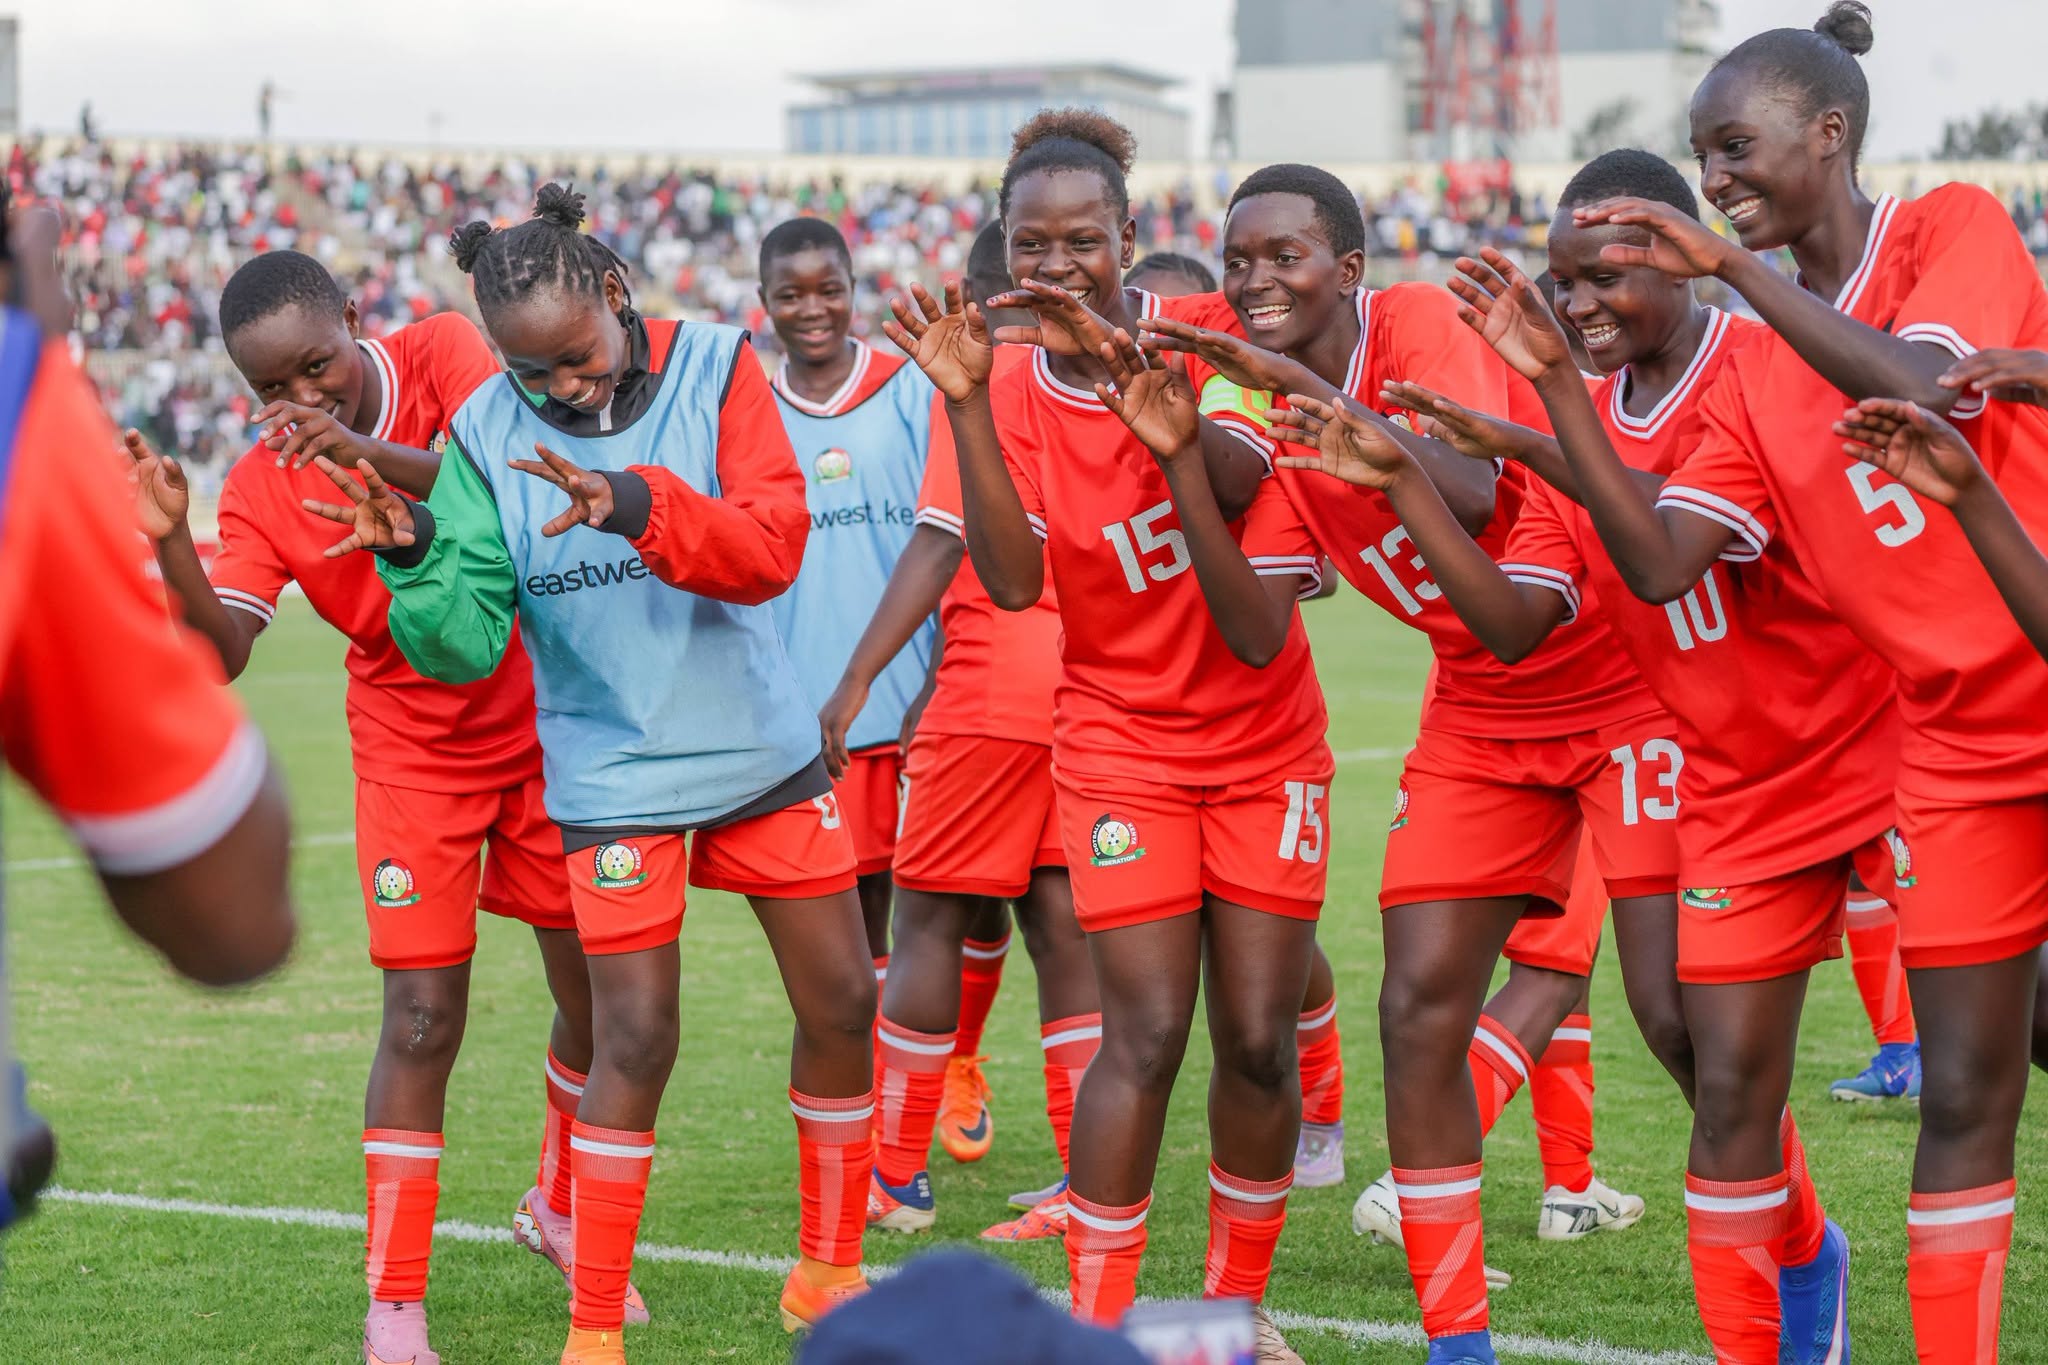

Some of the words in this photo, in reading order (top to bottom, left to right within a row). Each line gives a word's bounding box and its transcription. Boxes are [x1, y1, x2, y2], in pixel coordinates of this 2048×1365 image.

[809, 499, 914, 530] west.ke
[1845, 461, 1926, 547] 5
[1101, 499, 1192, 594] 15
[526, 557, 655, 597] eastwe
[1359, 524, 1443, 616] 13
[1664, 567, 1728, 651] 10
[1610, 738, 1685, 826] 13
[1092, 823, 1102, 857] FOOTBALL
[1127, 822, 1138, 846] KENYA
[1278, 781, 1325, 864] 15
[595, 845, 607, 878] FOOTBALL
[1098, 853, 1137, 868] FEDERATION
[600, 878, 640, 889] FEDERATION
